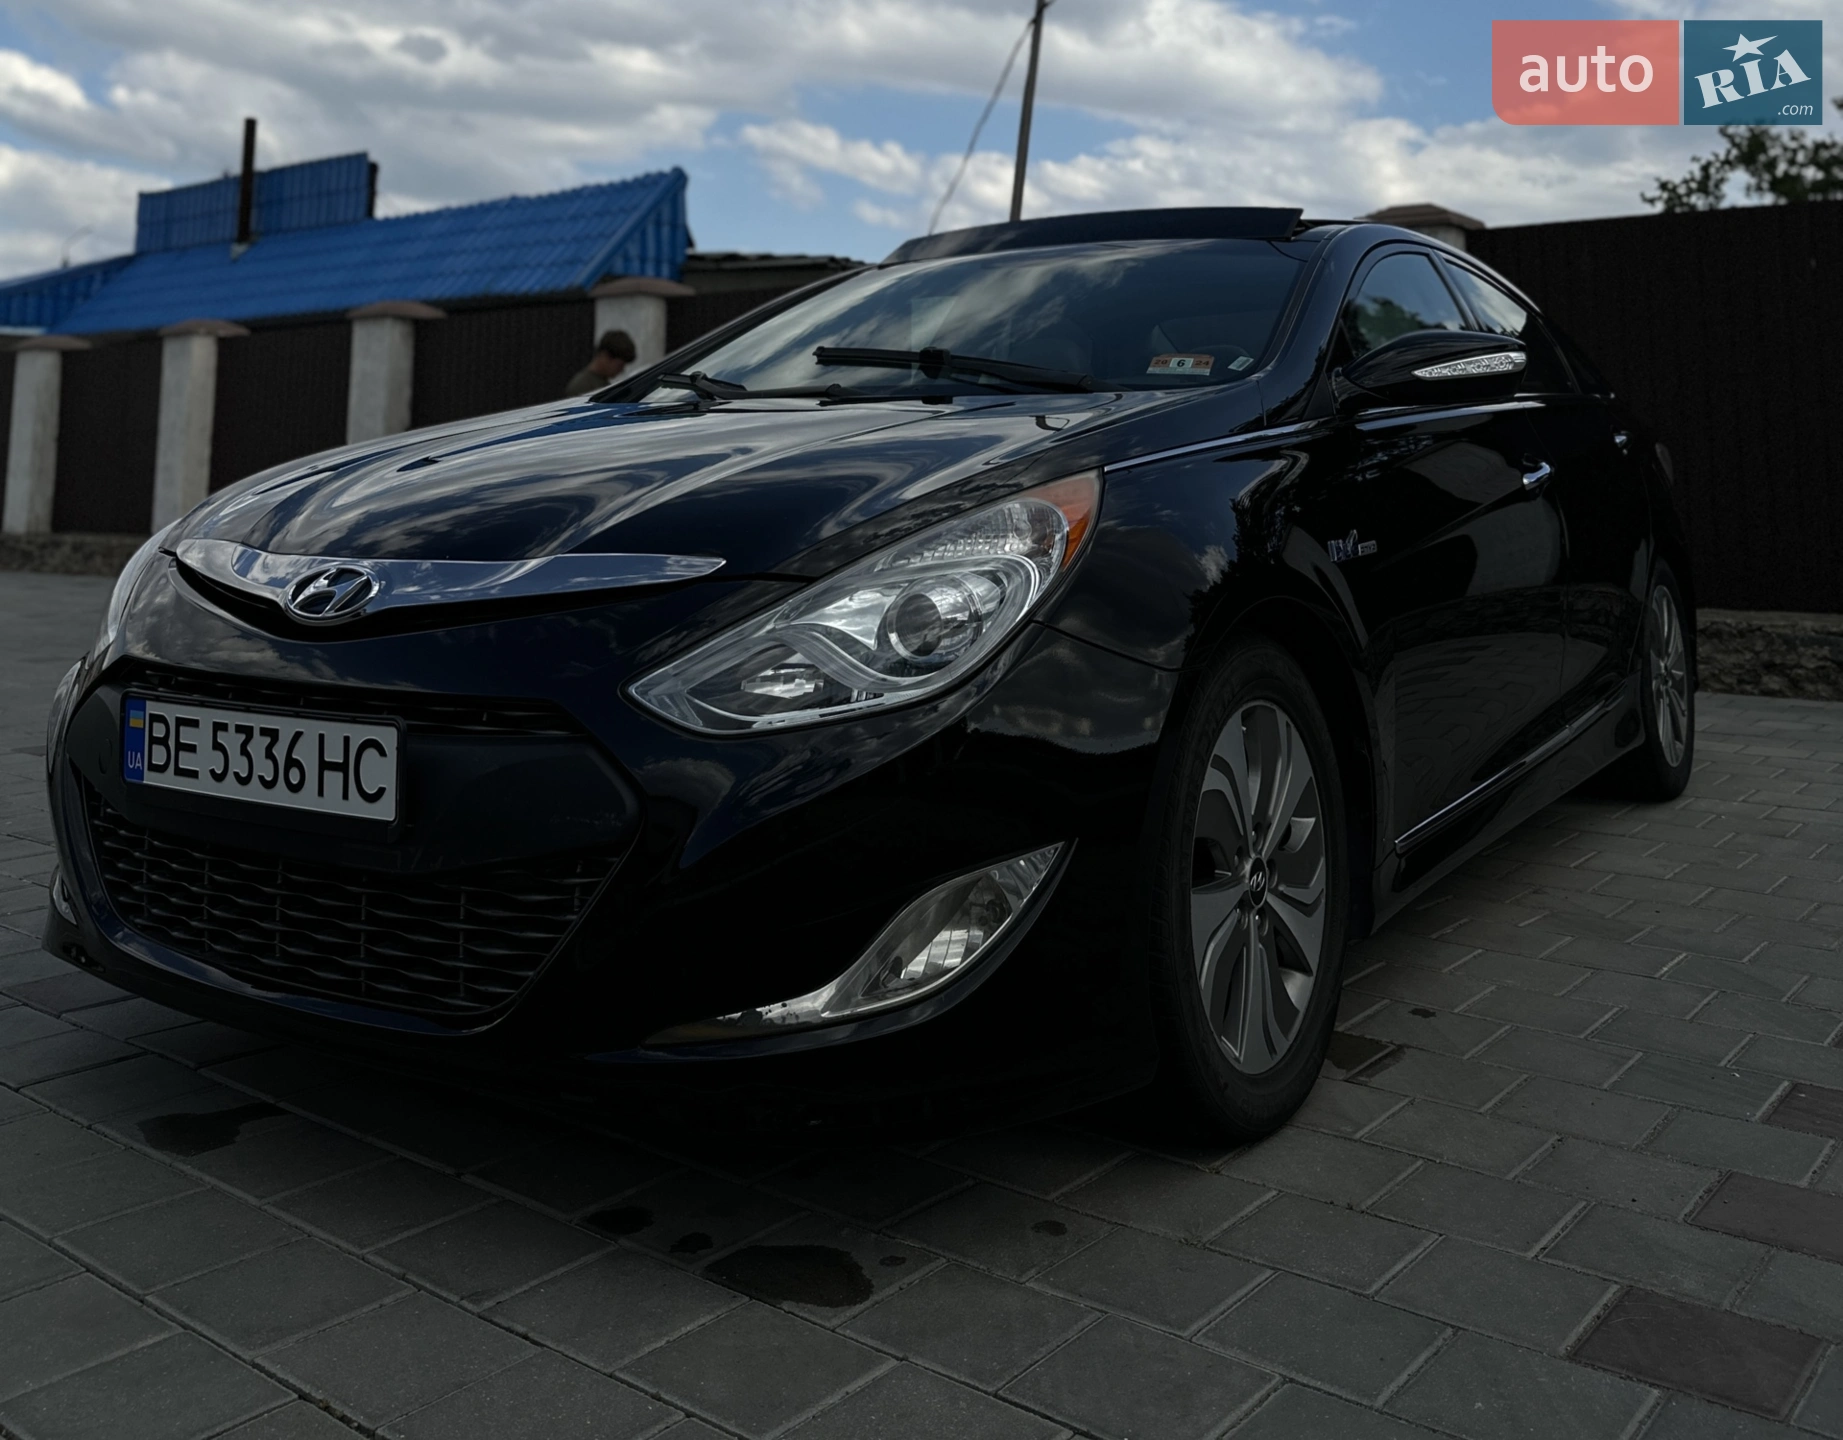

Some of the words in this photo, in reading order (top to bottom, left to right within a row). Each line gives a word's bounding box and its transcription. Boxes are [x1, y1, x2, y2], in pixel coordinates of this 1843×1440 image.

[1177, 359, 1186, 367] 6
[127, 751, 143, 771] UA
[147, 712, 200, 780] BE
[208, 720, 307, 794] 5336
[317, 732, 389, 804] HC
